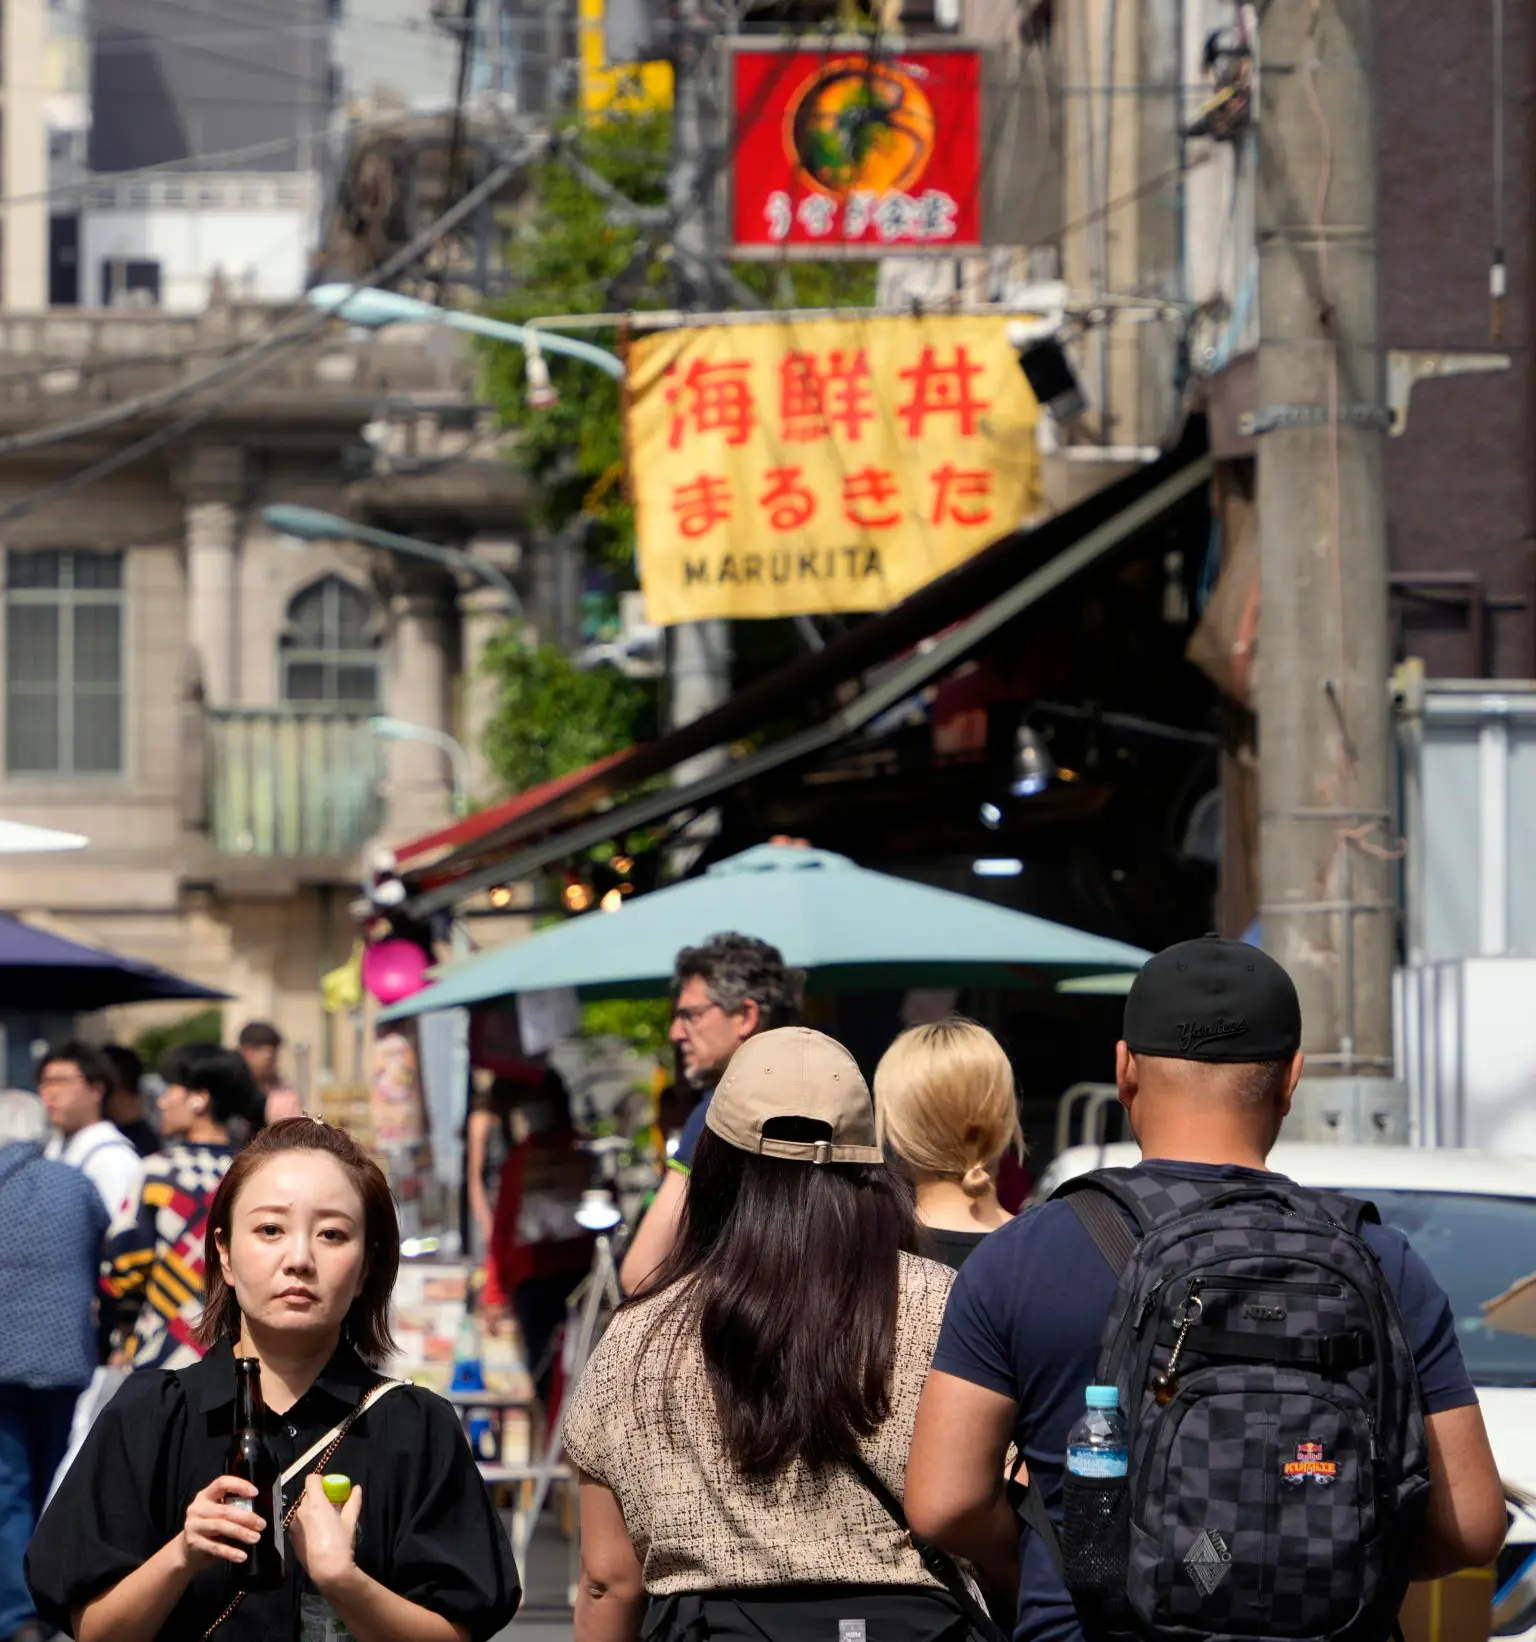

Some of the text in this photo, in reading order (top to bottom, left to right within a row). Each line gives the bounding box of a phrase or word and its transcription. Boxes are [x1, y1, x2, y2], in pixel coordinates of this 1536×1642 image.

[664, 343, 990, 450] 海鮮丼
[671, 463, 994, 540] まるきた
[682, 545, 885, 587] MARUKITA
[1176, 1018, 1249, 1053] Yankees
[1240, 1304, 1287, 1321] NITRO
[1207, 1529, 1233, 1562] NITRO
